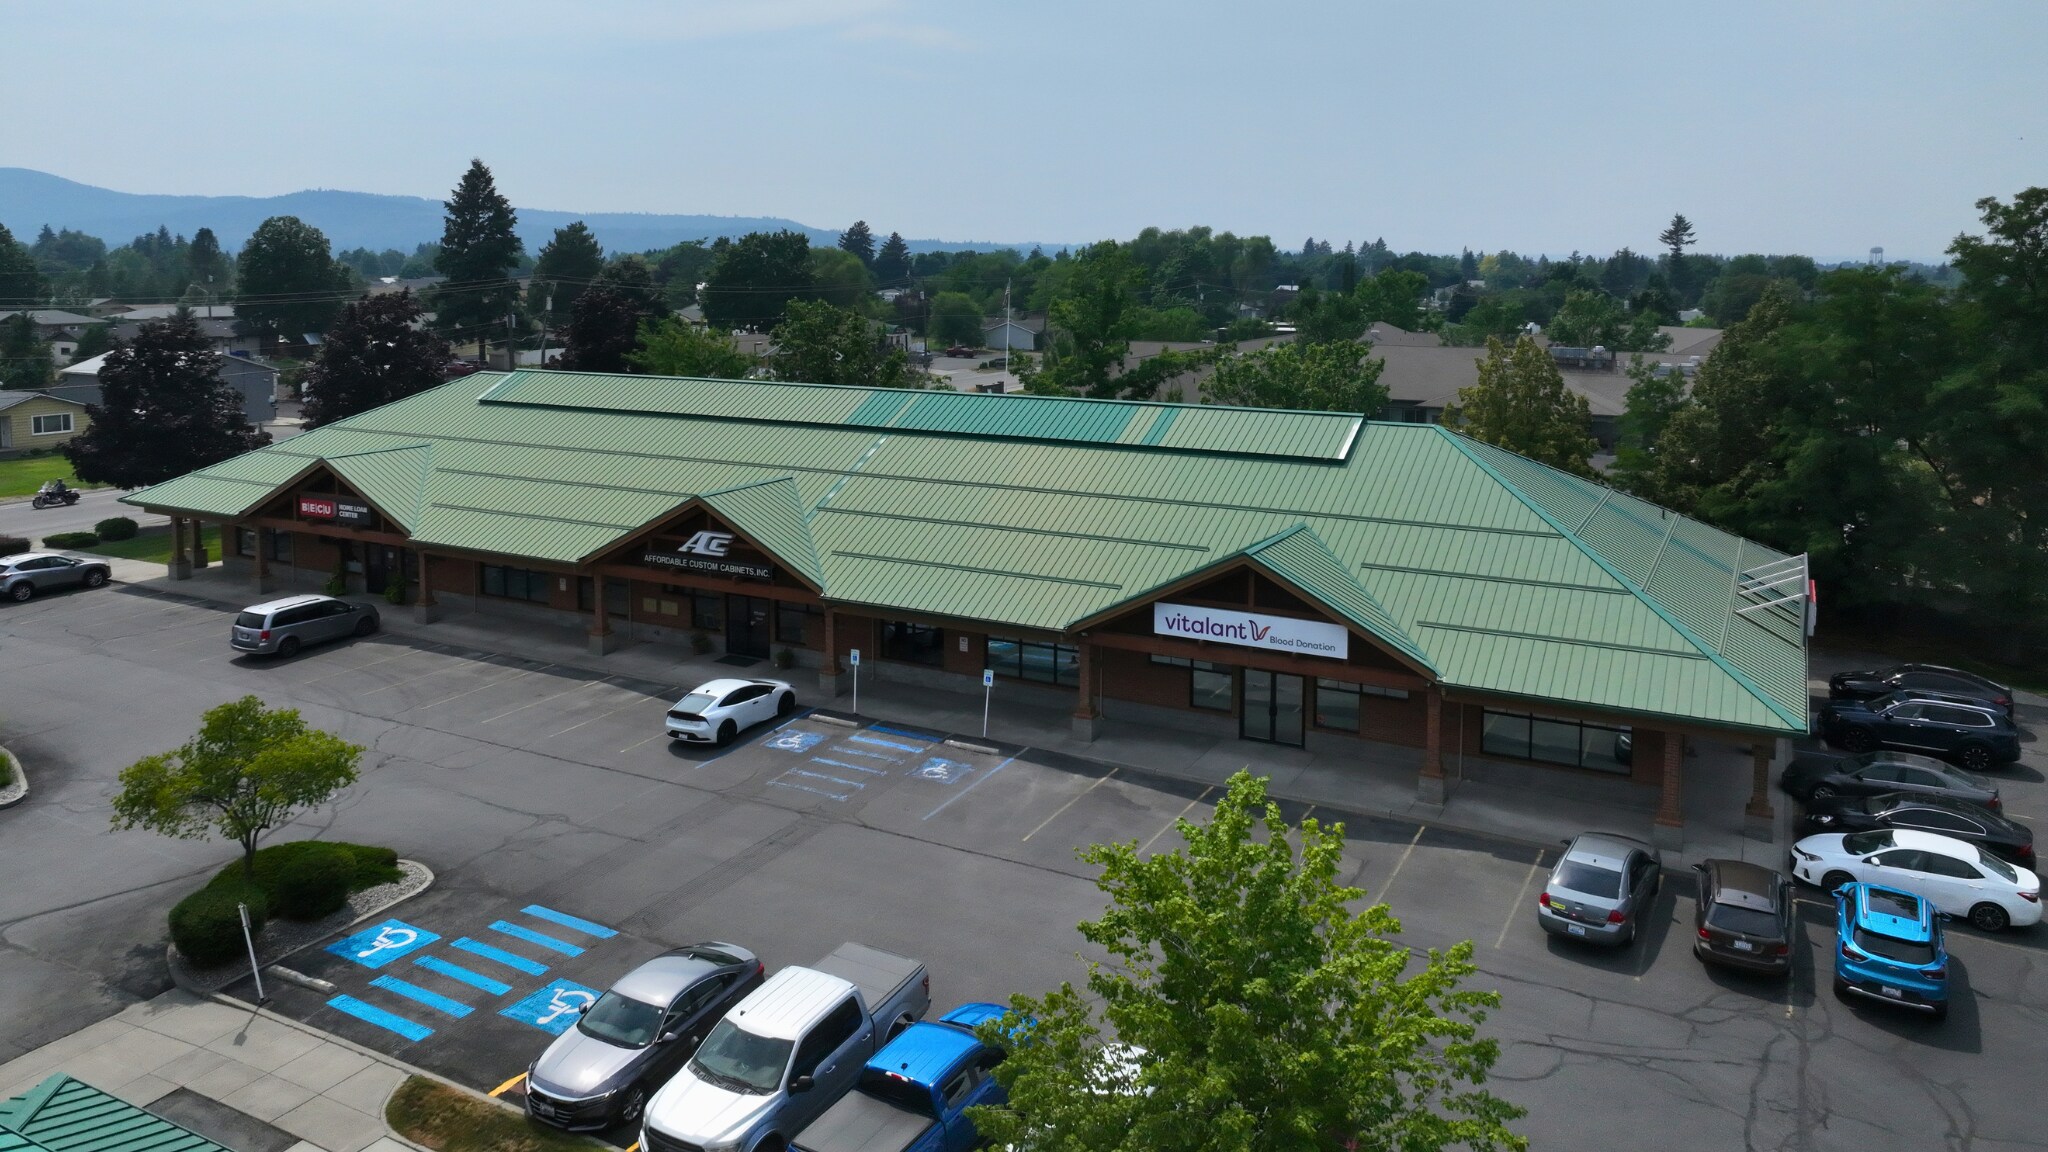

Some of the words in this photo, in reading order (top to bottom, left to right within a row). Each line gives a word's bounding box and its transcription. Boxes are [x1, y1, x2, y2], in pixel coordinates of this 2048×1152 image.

[339, 511, 358, 519] CENTER
[644, 554, 688, 567] AFFORDABLE
[689, 560, 718, 571] CUSTOM
[1165, 612, 1247, 640] vitalant
[1269, 635, 1294, 647] Blood
[1296, 639, 1336, 652] Donation
